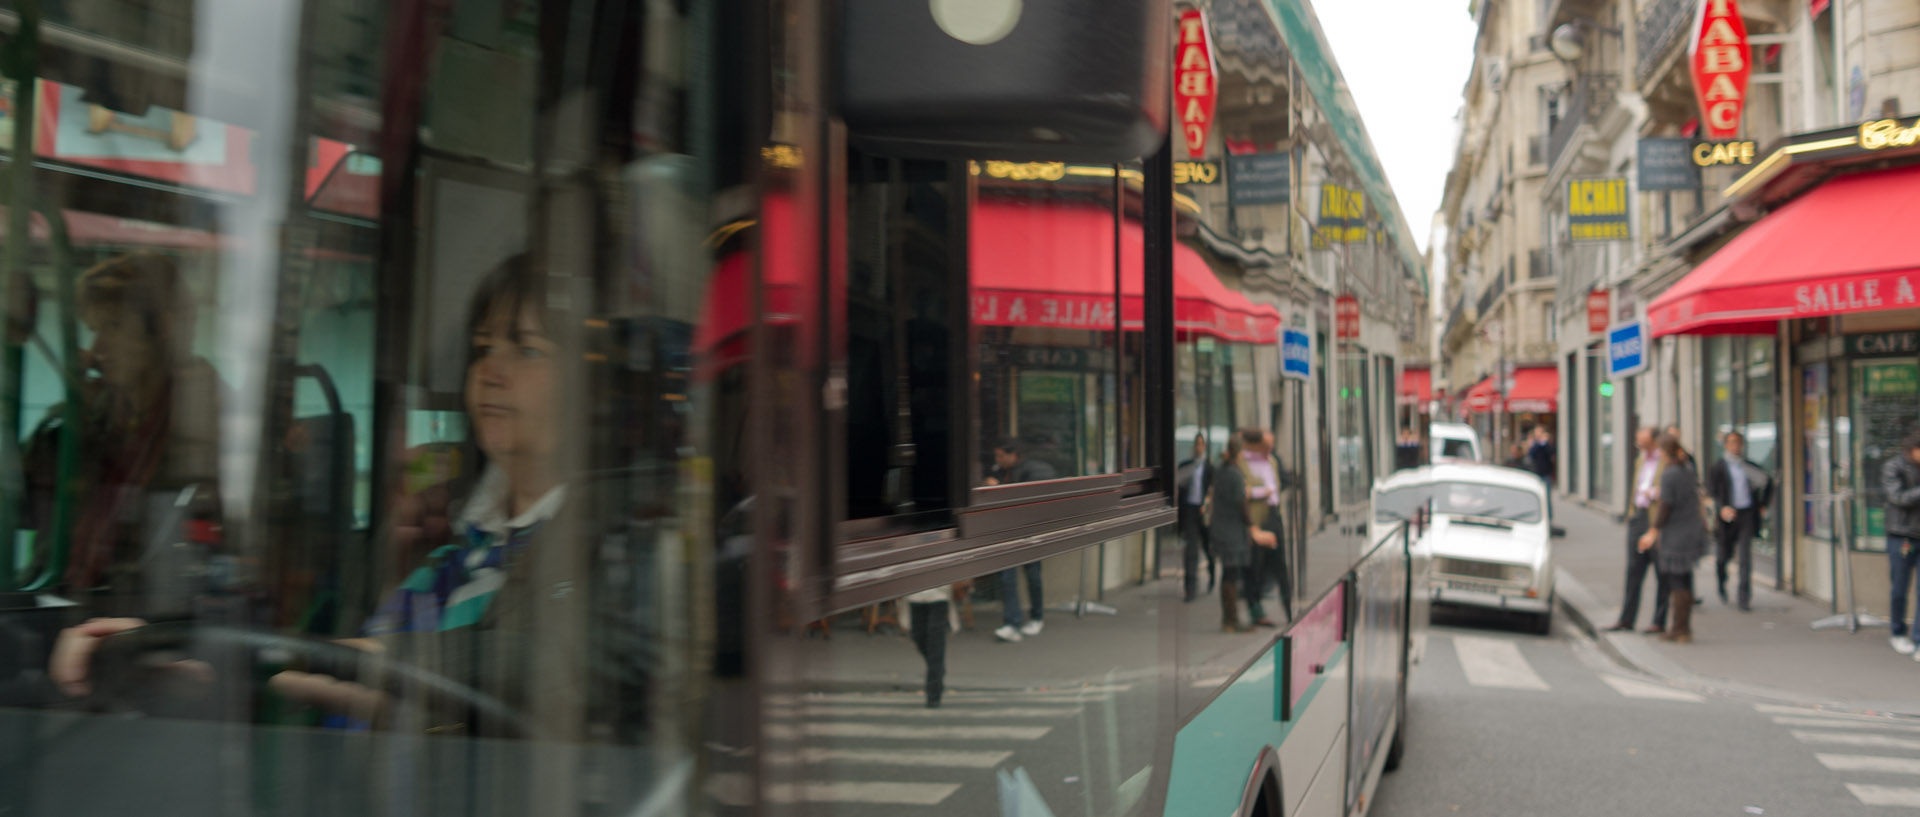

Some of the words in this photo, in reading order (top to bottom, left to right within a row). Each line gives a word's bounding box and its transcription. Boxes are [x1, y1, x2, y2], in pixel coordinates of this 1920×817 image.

[1693, 141, 1755, 166] CAFE
[1570, 179, 1627, 216] ACHAT
[1796, 279, 1882, 312] SALLE
[1896, 276, 1915, 304] A
[1857, 333, 1917, 354] CAFE
